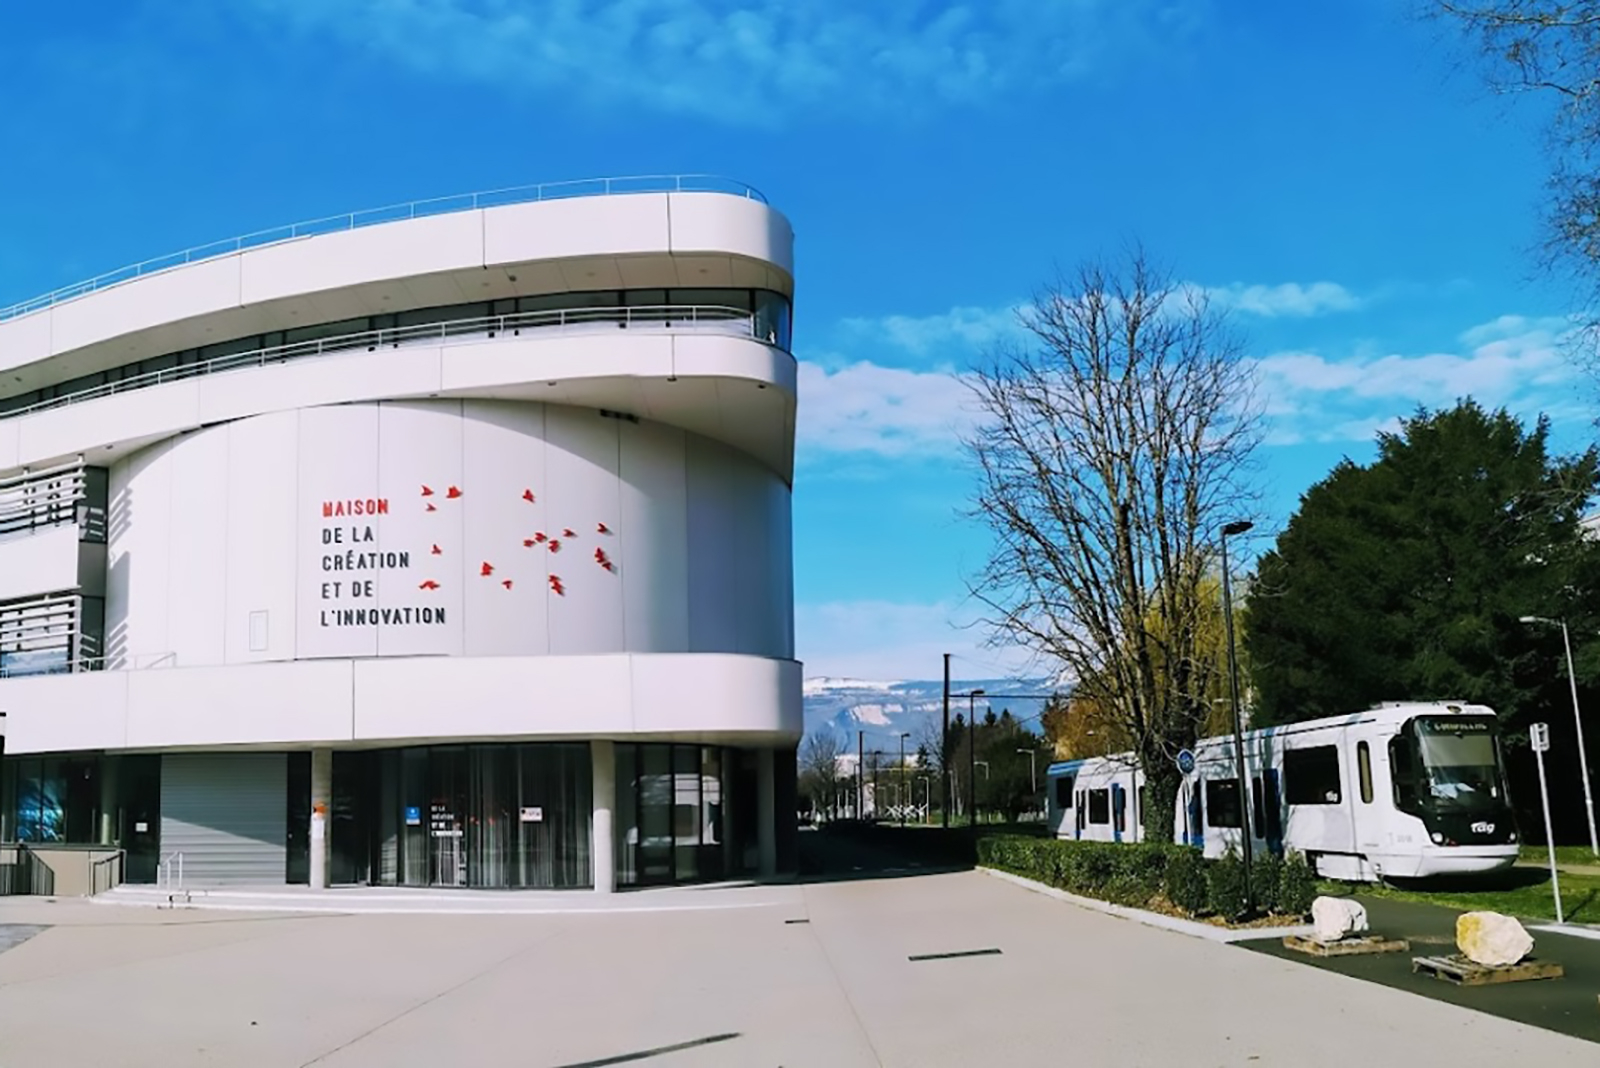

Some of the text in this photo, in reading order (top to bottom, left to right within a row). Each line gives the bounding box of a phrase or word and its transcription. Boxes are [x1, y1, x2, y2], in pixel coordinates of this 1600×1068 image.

[323, 498, 388, 517] MAISON
[322, 526, 374, 545] DE LA
[322, 549, 409, 571] CRÉATION
[321, 580, 373, 599] ET DE
[320, 607, 445, 627] L'INNOVATION
